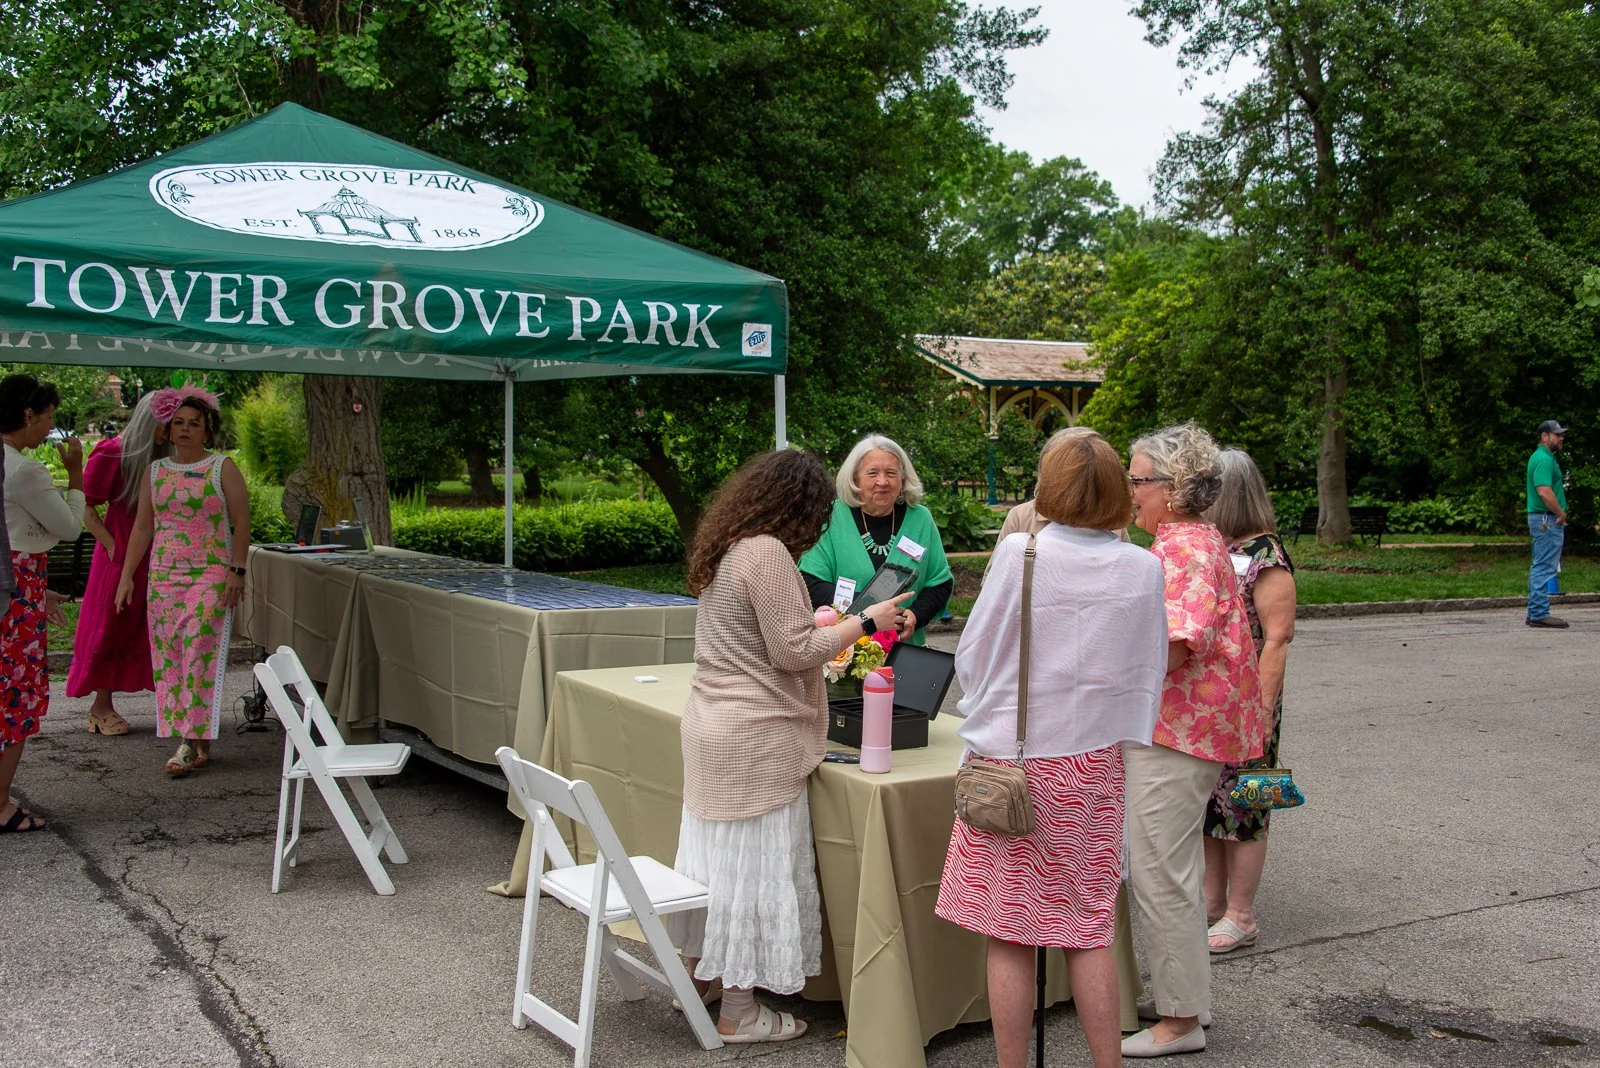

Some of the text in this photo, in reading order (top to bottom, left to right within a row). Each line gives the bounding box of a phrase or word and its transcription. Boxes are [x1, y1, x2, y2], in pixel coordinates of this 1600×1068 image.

[196, 168, 480, 194] TOWER GROVE PARK
[242, 218, 481, 239] EST. 1868
[12, 255, 723, 349] TOWER GROVE PARK
